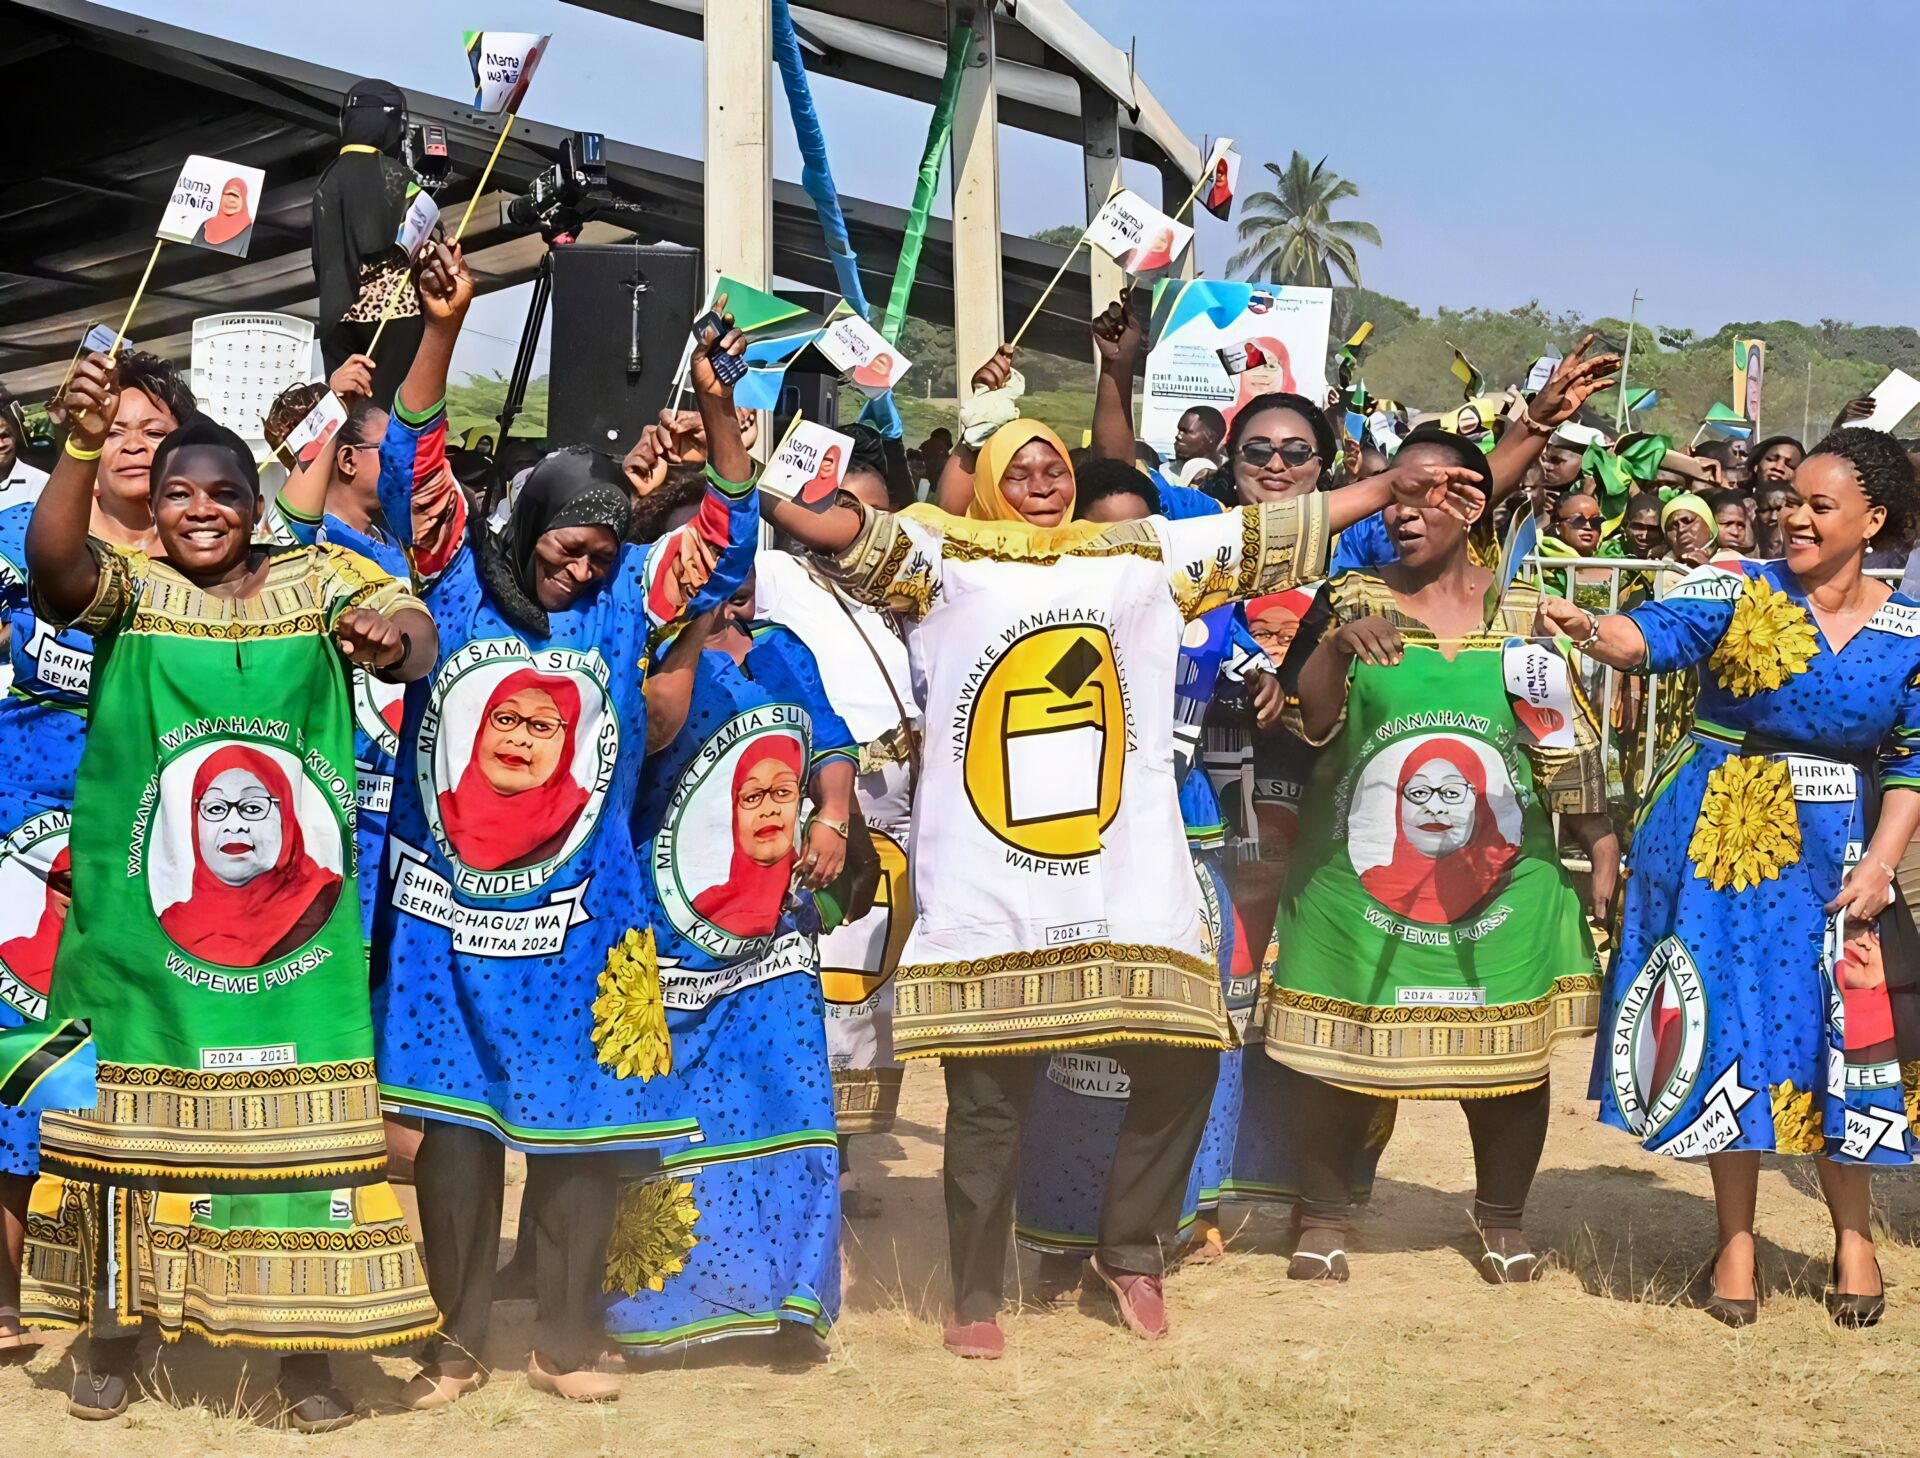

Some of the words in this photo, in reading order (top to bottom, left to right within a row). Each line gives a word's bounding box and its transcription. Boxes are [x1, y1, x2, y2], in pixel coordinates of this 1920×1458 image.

[952, 644, 1000, 763] WANAWAKE
[1000, 607, 1105, 644] WANAHAKI
[160, 717, 290, 751] WANAHAKI
[703, 713, 763, 763] SAMIA
[1005, 848, 1091, 877] WAPEWE
[534, 914, 561, 931] WA
[685, 920, 730, 955] KAZI
[468, 935, 517, 951] MITAA
[521, 936, 559, 951] 2024
[165, 950, 259, 994] WAPEWE
[264, 945, 334, 991] FURSA
[1614, 986, 1649, 1056] SAMIA
[209, 1052, 243, 1065] 2024
[1615, 1068, 1639, 1113] DKT
[1702, 1109, 1726, 1133] WA
[1847, 1118, 1872, 1140] WA
